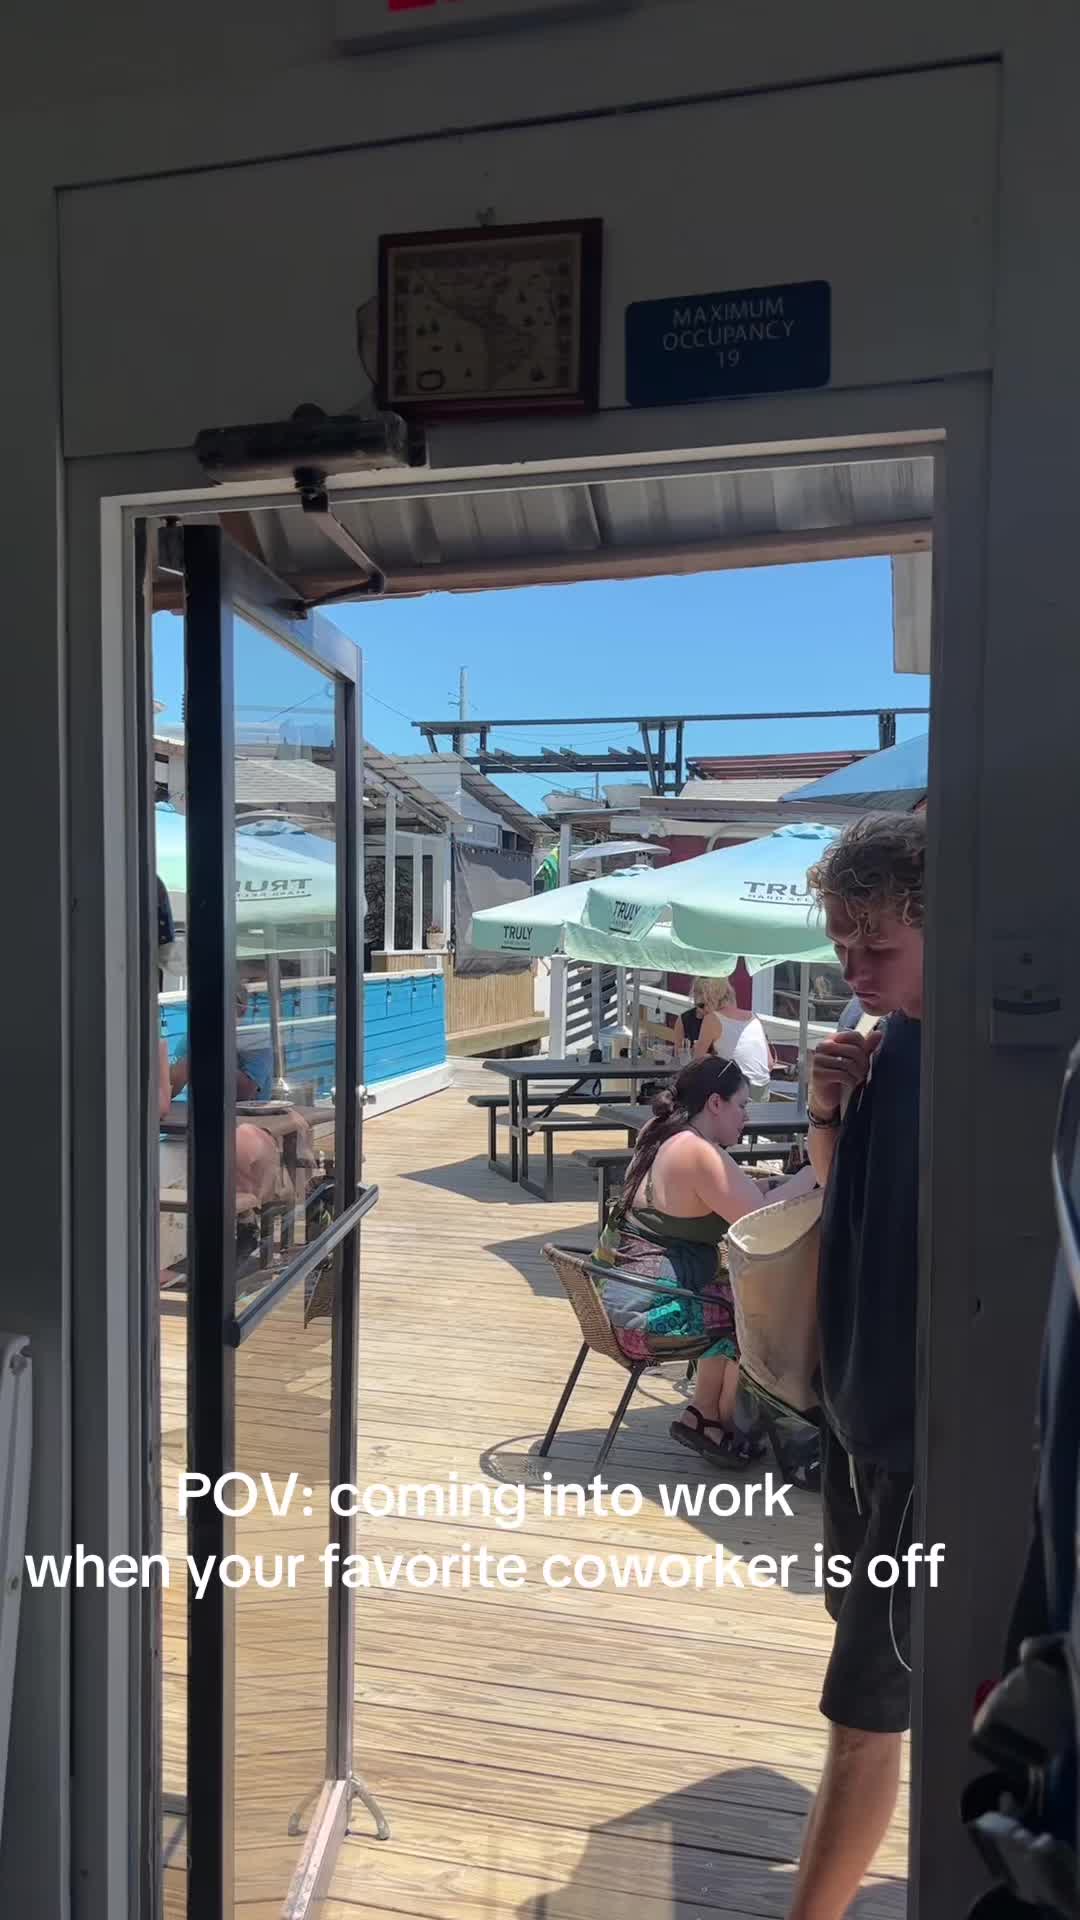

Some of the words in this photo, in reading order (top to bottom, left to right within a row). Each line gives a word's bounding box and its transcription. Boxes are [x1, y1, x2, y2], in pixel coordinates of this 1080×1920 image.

[672, 296, 784, 329] MAXIMUM
[662, 320, 795, 351] OCCUPANCY
[716, 349, 740, 368] 19
[744, 881, 809, 896] TRU
[614, 901, 641, 920] TRULY
[504, 926, 533, 940] TRULY
